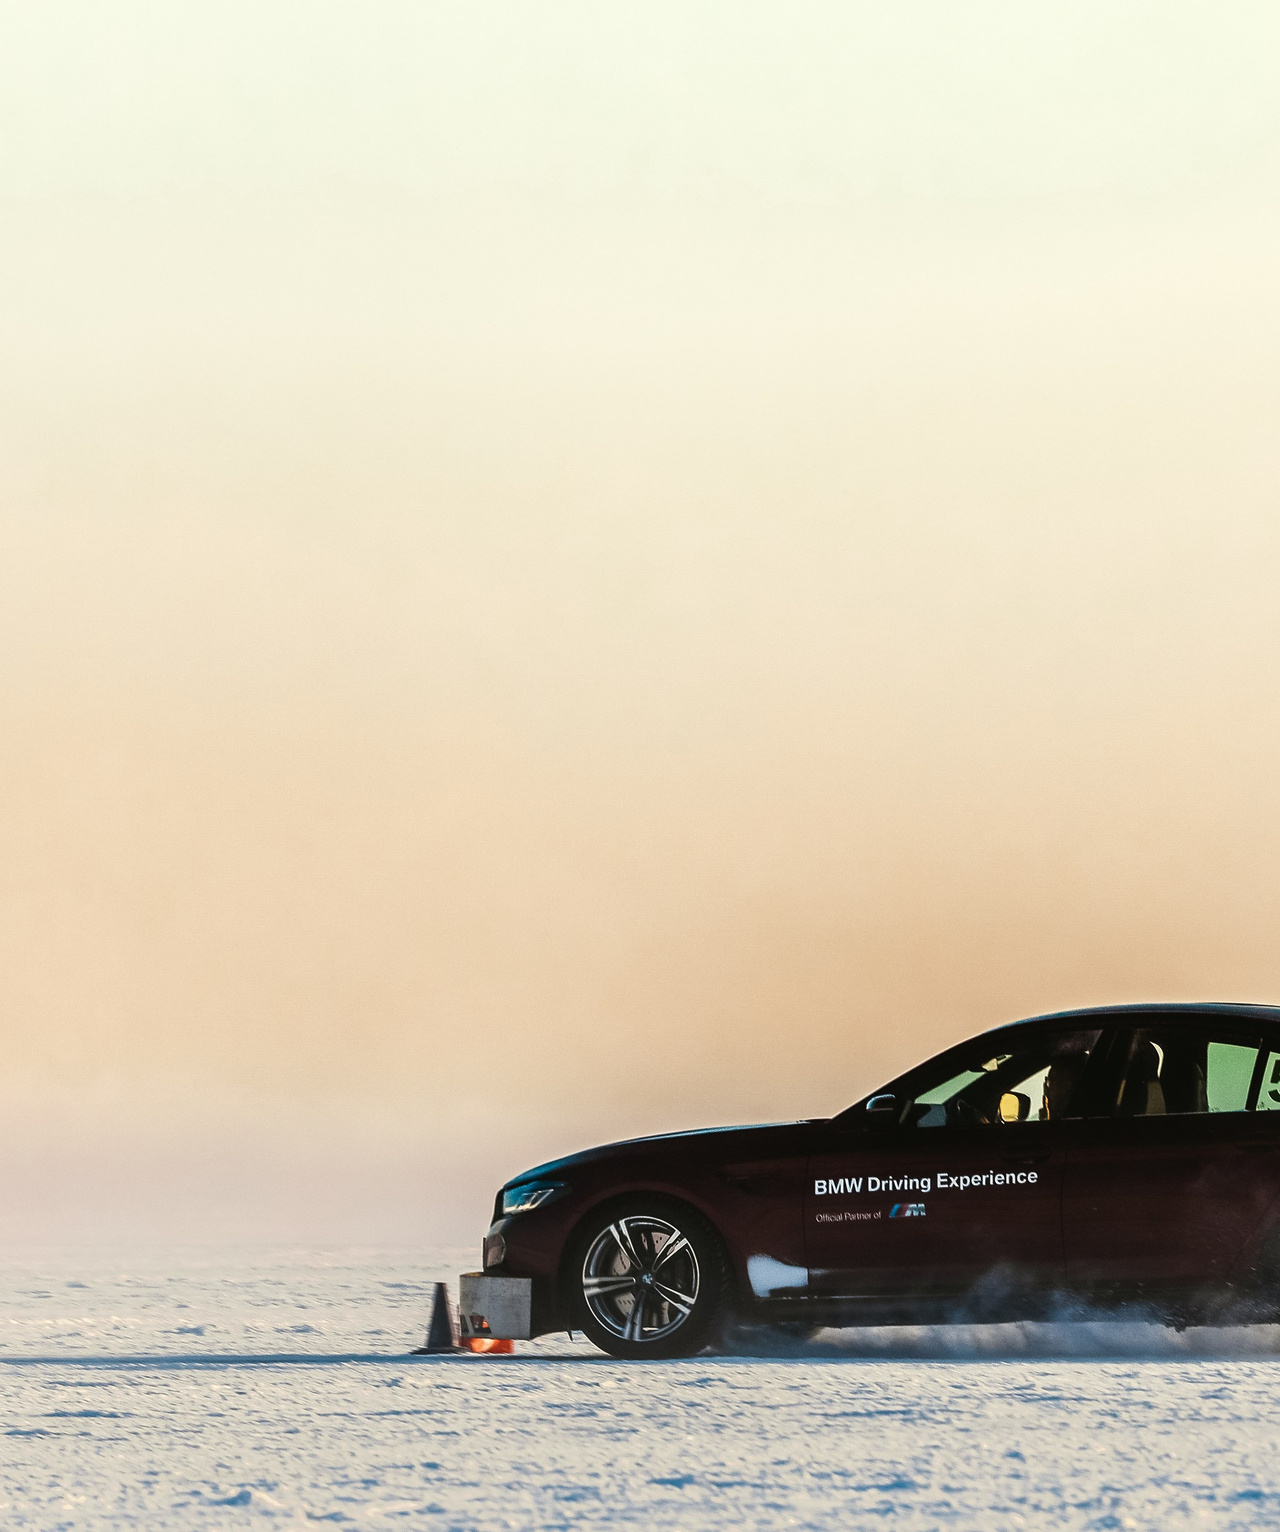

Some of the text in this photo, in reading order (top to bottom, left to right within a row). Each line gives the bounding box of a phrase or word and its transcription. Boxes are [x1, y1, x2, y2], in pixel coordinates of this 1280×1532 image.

[814, 1170, 1038, 1195] BMW Driving Experience
[815, 1213, 844, 1222] Official
[844, 1211, 872, 1221] Partner
[873, 1210, 882, 1219] of
